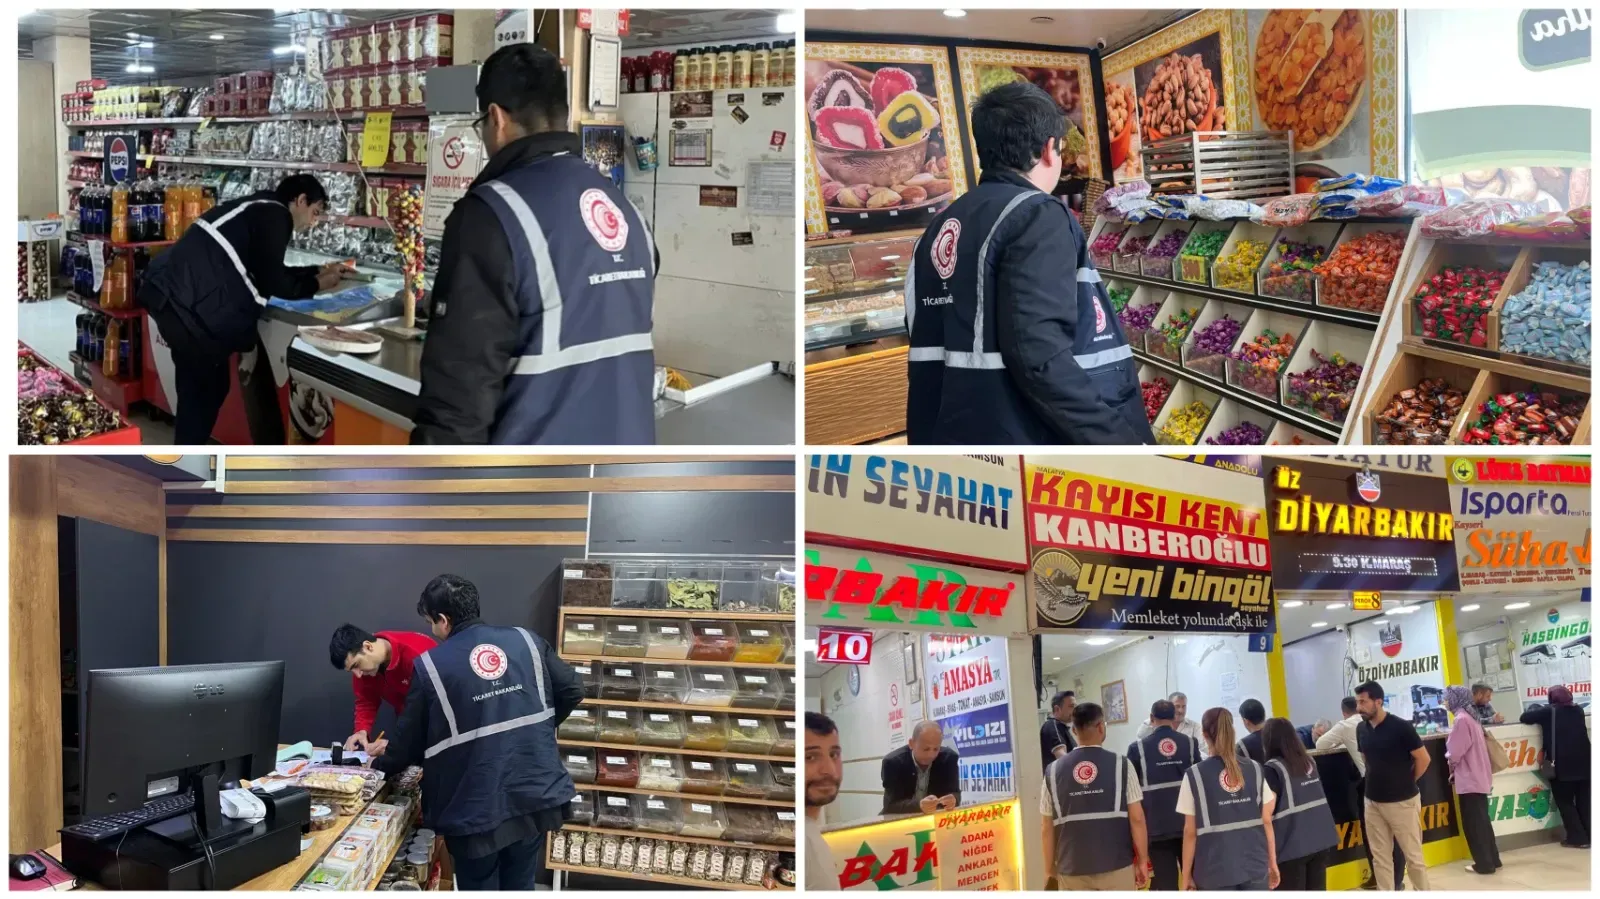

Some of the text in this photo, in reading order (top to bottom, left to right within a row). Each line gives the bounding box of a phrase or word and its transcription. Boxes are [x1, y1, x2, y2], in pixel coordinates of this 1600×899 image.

[110, 155, 128, 166] PEPSI
[1214, 459, 1258, 476] ANADOLU
[863, 455, 1013, 530] SEYAHAT
[1460, 487, 1568, 519] Isparta
[1031, 472, 1261, 537] KAYISI KENT
[1277, 495, 1454, 541] DİYARBAKIR
[1454, 520, 1484, 530] Kayseri
[1034, 512, 1267, 567] KANBEROĞLU
[1462, 528, 1568, 568] Süha
[1332, 556, 1412, 573] 9.30 K.MARAŞ
[1076, 563, 1272, 608] yeni bingöl
[1371, 592, 1380, 609] 8
[1111, 608, 1180, 626] Memleket
[1183, 613, 1230, 630] yolunda
[1255, 614, 1268, 627] ile
[1259, 636, 1266, 650] 9
[1522, 618, 1591, 646] HASBİNGÖ
[820, 632, 869, 661] 10
[943, 656, 993, 697] AMASYA
[1358, 654, 1439, 683] ÖZDİYARBAKIR
[954, 720, 1006, 741] YILDIZI
[971, 761, 1011, 792] SEYAHAT
[938, 805, 1012, 828] DİYARBAKIR
[960, 829, 995, 845] ADANA
[963, 843, 994, 859] NİĞDE
[957, 855, 999, 874] ANKARA
[957, 868, 999, 888] MENGEN
